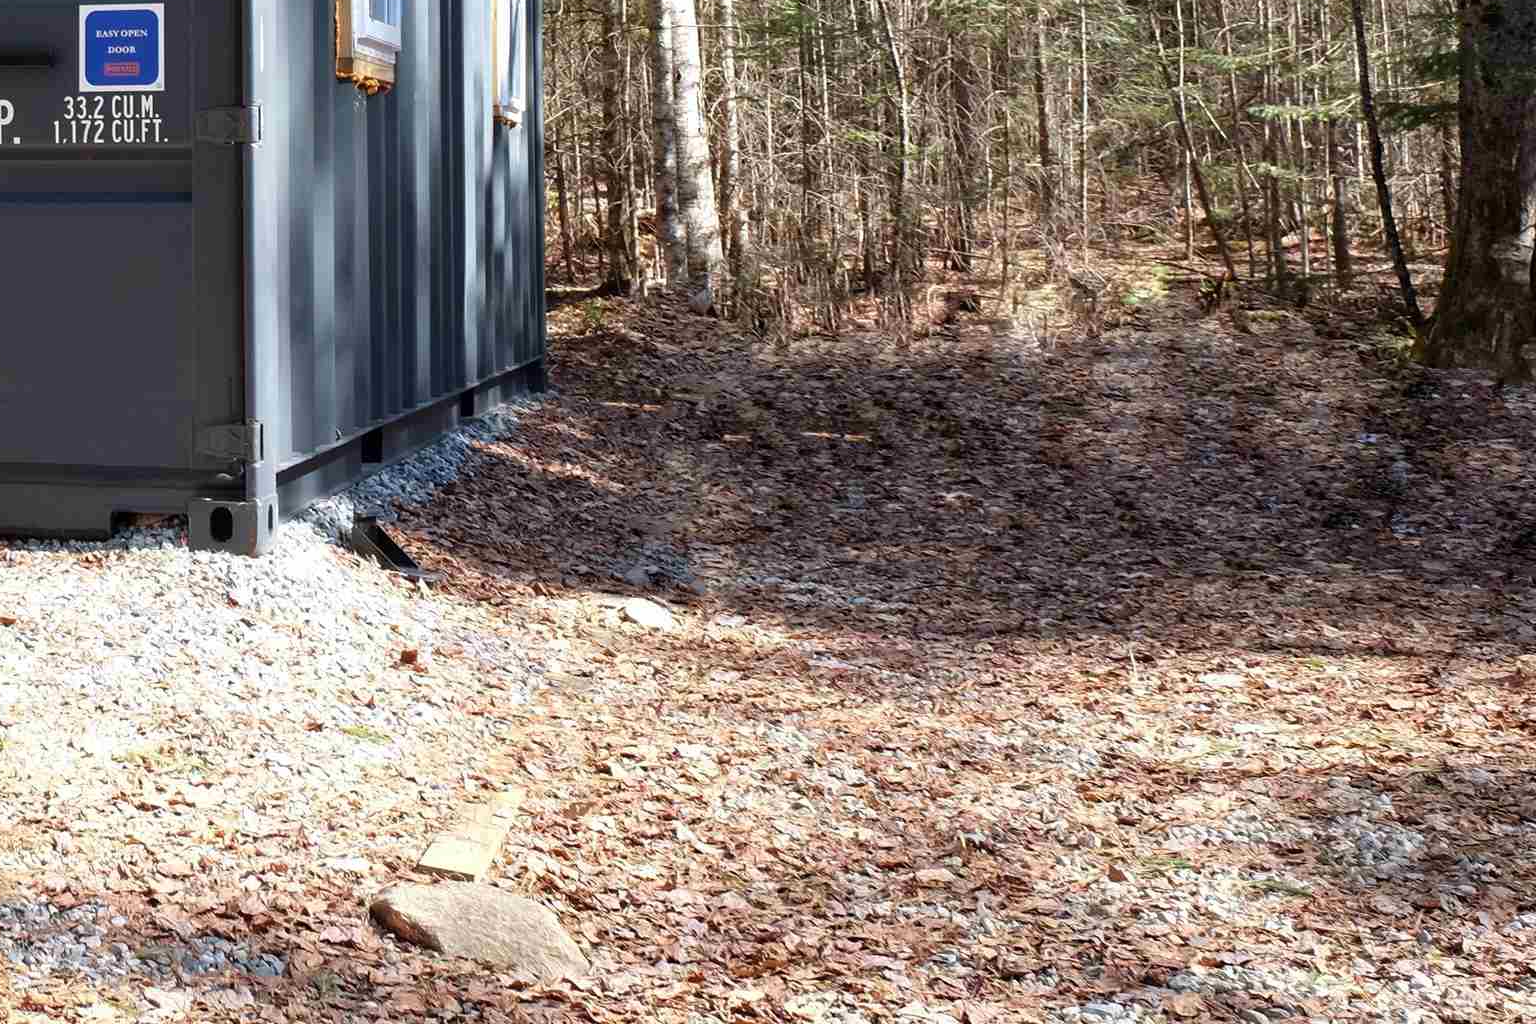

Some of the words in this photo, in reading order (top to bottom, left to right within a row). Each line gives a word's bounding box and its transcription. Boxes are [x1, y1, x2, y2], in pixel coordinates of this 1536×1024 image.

[95, 29, 120, 38] EASY
[120, 28, 148, 38] OPEN
[107, 46, 137, 54] DOOR
[63, 95, 105, 119] 33.2
[111, 94, 160, 119] CU.M.
[53, 120, 105, 145] 1,172
[111, 119, 169, 144] CU.FT.
